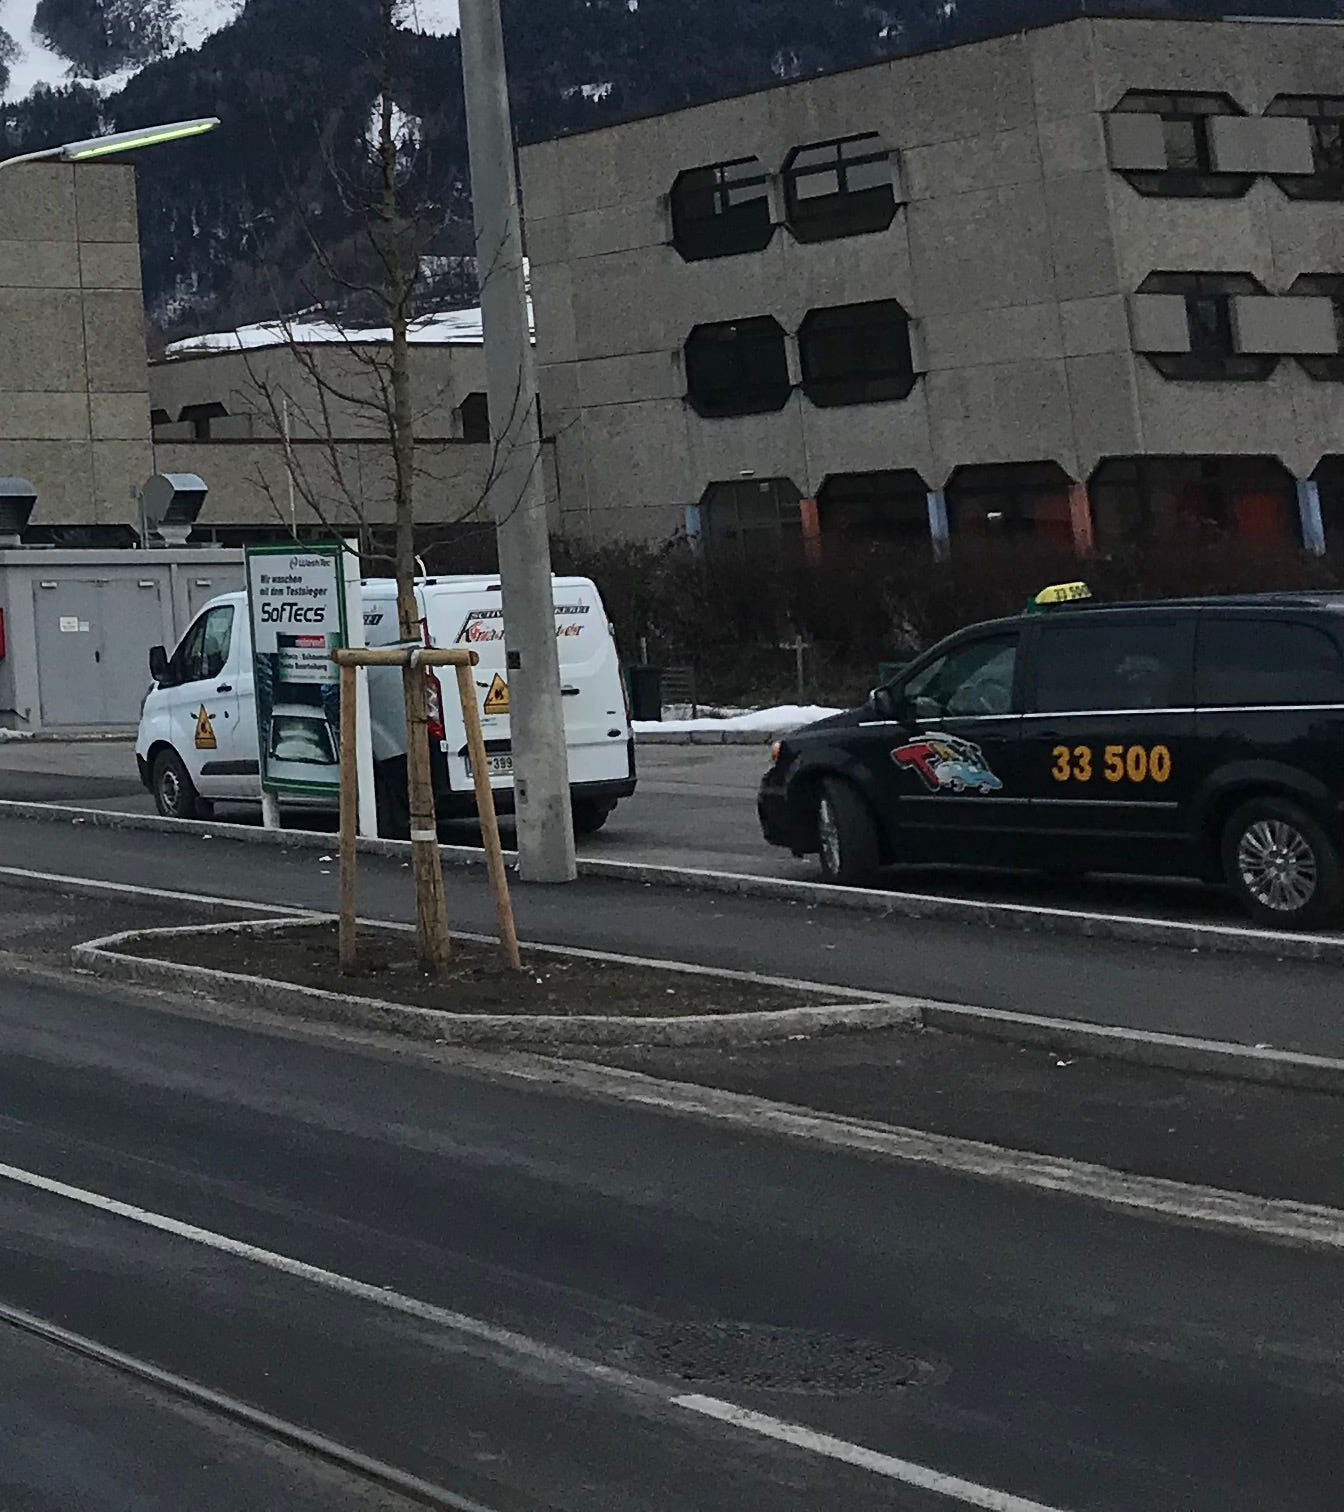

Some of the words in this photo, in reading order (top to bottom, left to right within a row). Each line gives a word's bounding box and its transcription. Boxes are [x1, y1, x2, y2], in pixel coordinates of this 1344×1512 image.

[272, 575, 302, 584] waschen
[286, 586, 328, 598] Testsieger
[1051, 744, 1092, 782] 33
[1103, 744, 1172, 783] 500
